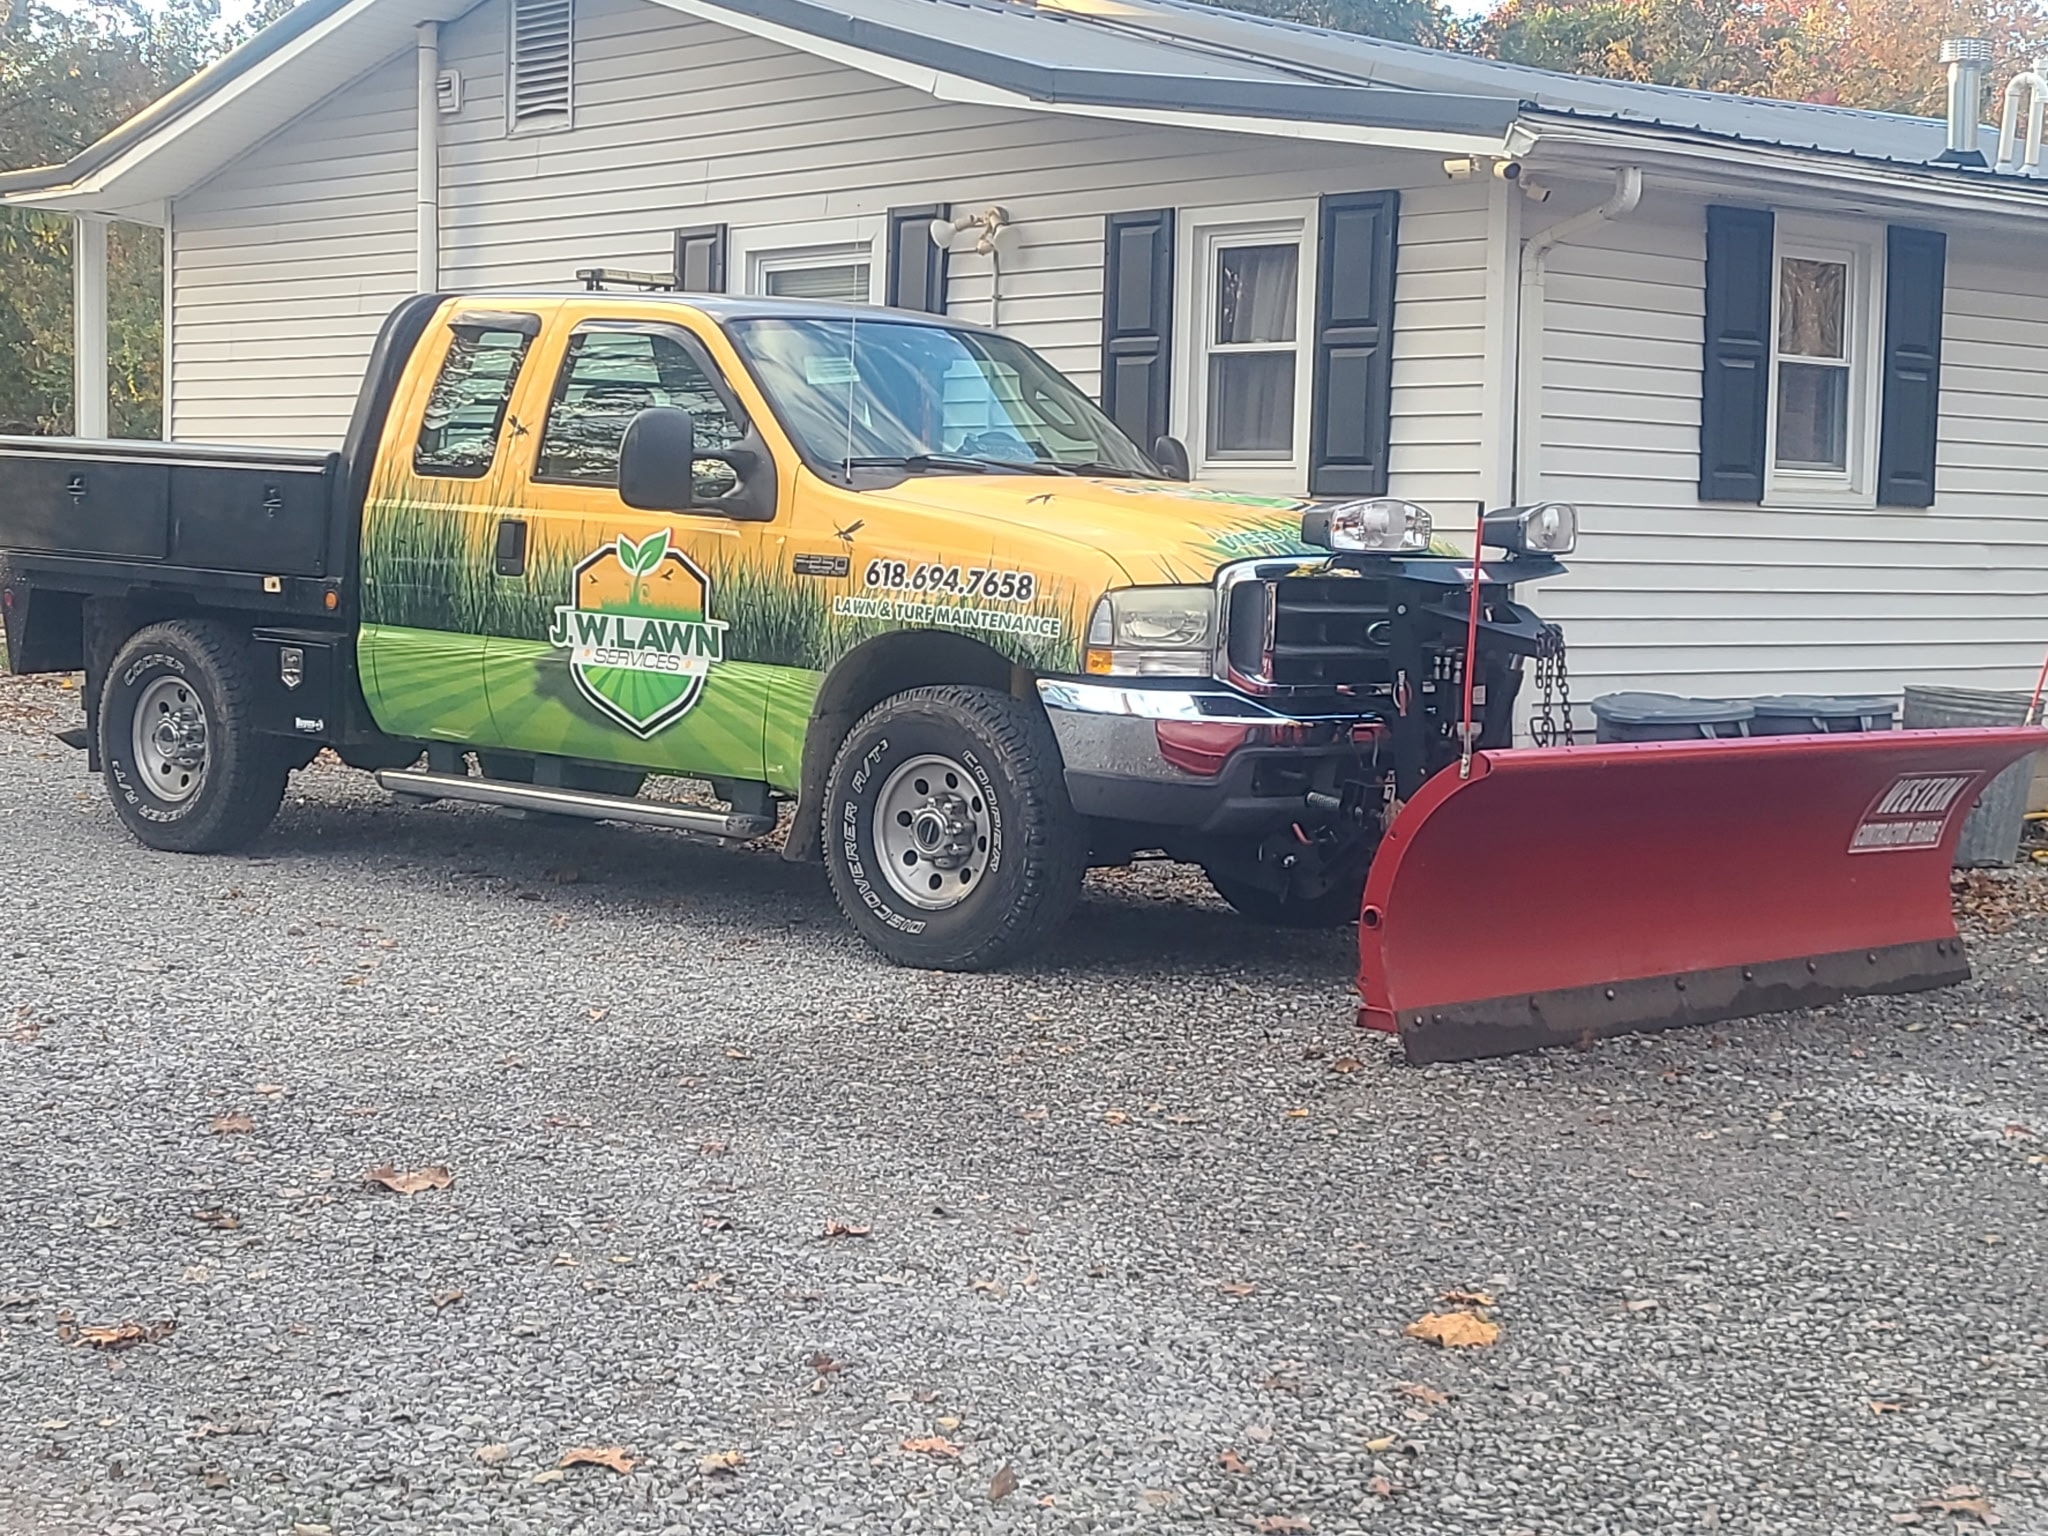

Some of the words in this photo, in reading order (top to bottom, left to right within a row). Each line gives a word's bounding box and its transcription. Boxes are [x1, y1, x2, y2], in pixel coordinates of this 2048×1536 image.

[866, 560, 1034, 600] 618.694.7658
[834, 598, 877, 616] LAWN
[879, 601, 891, 618] &
[896, 603, 932, 621] TURF
[936, 605, 1060, 636] MAINTENANCE
[123, 653, 186, 687] COOPER
[593, 648, 681, 671] SERVICES
[962, 750, 1002, 873] COOPER
[1876, 777, 1969, 814] WESTERN
[842, 801, 926, 935] DISCOVERER
